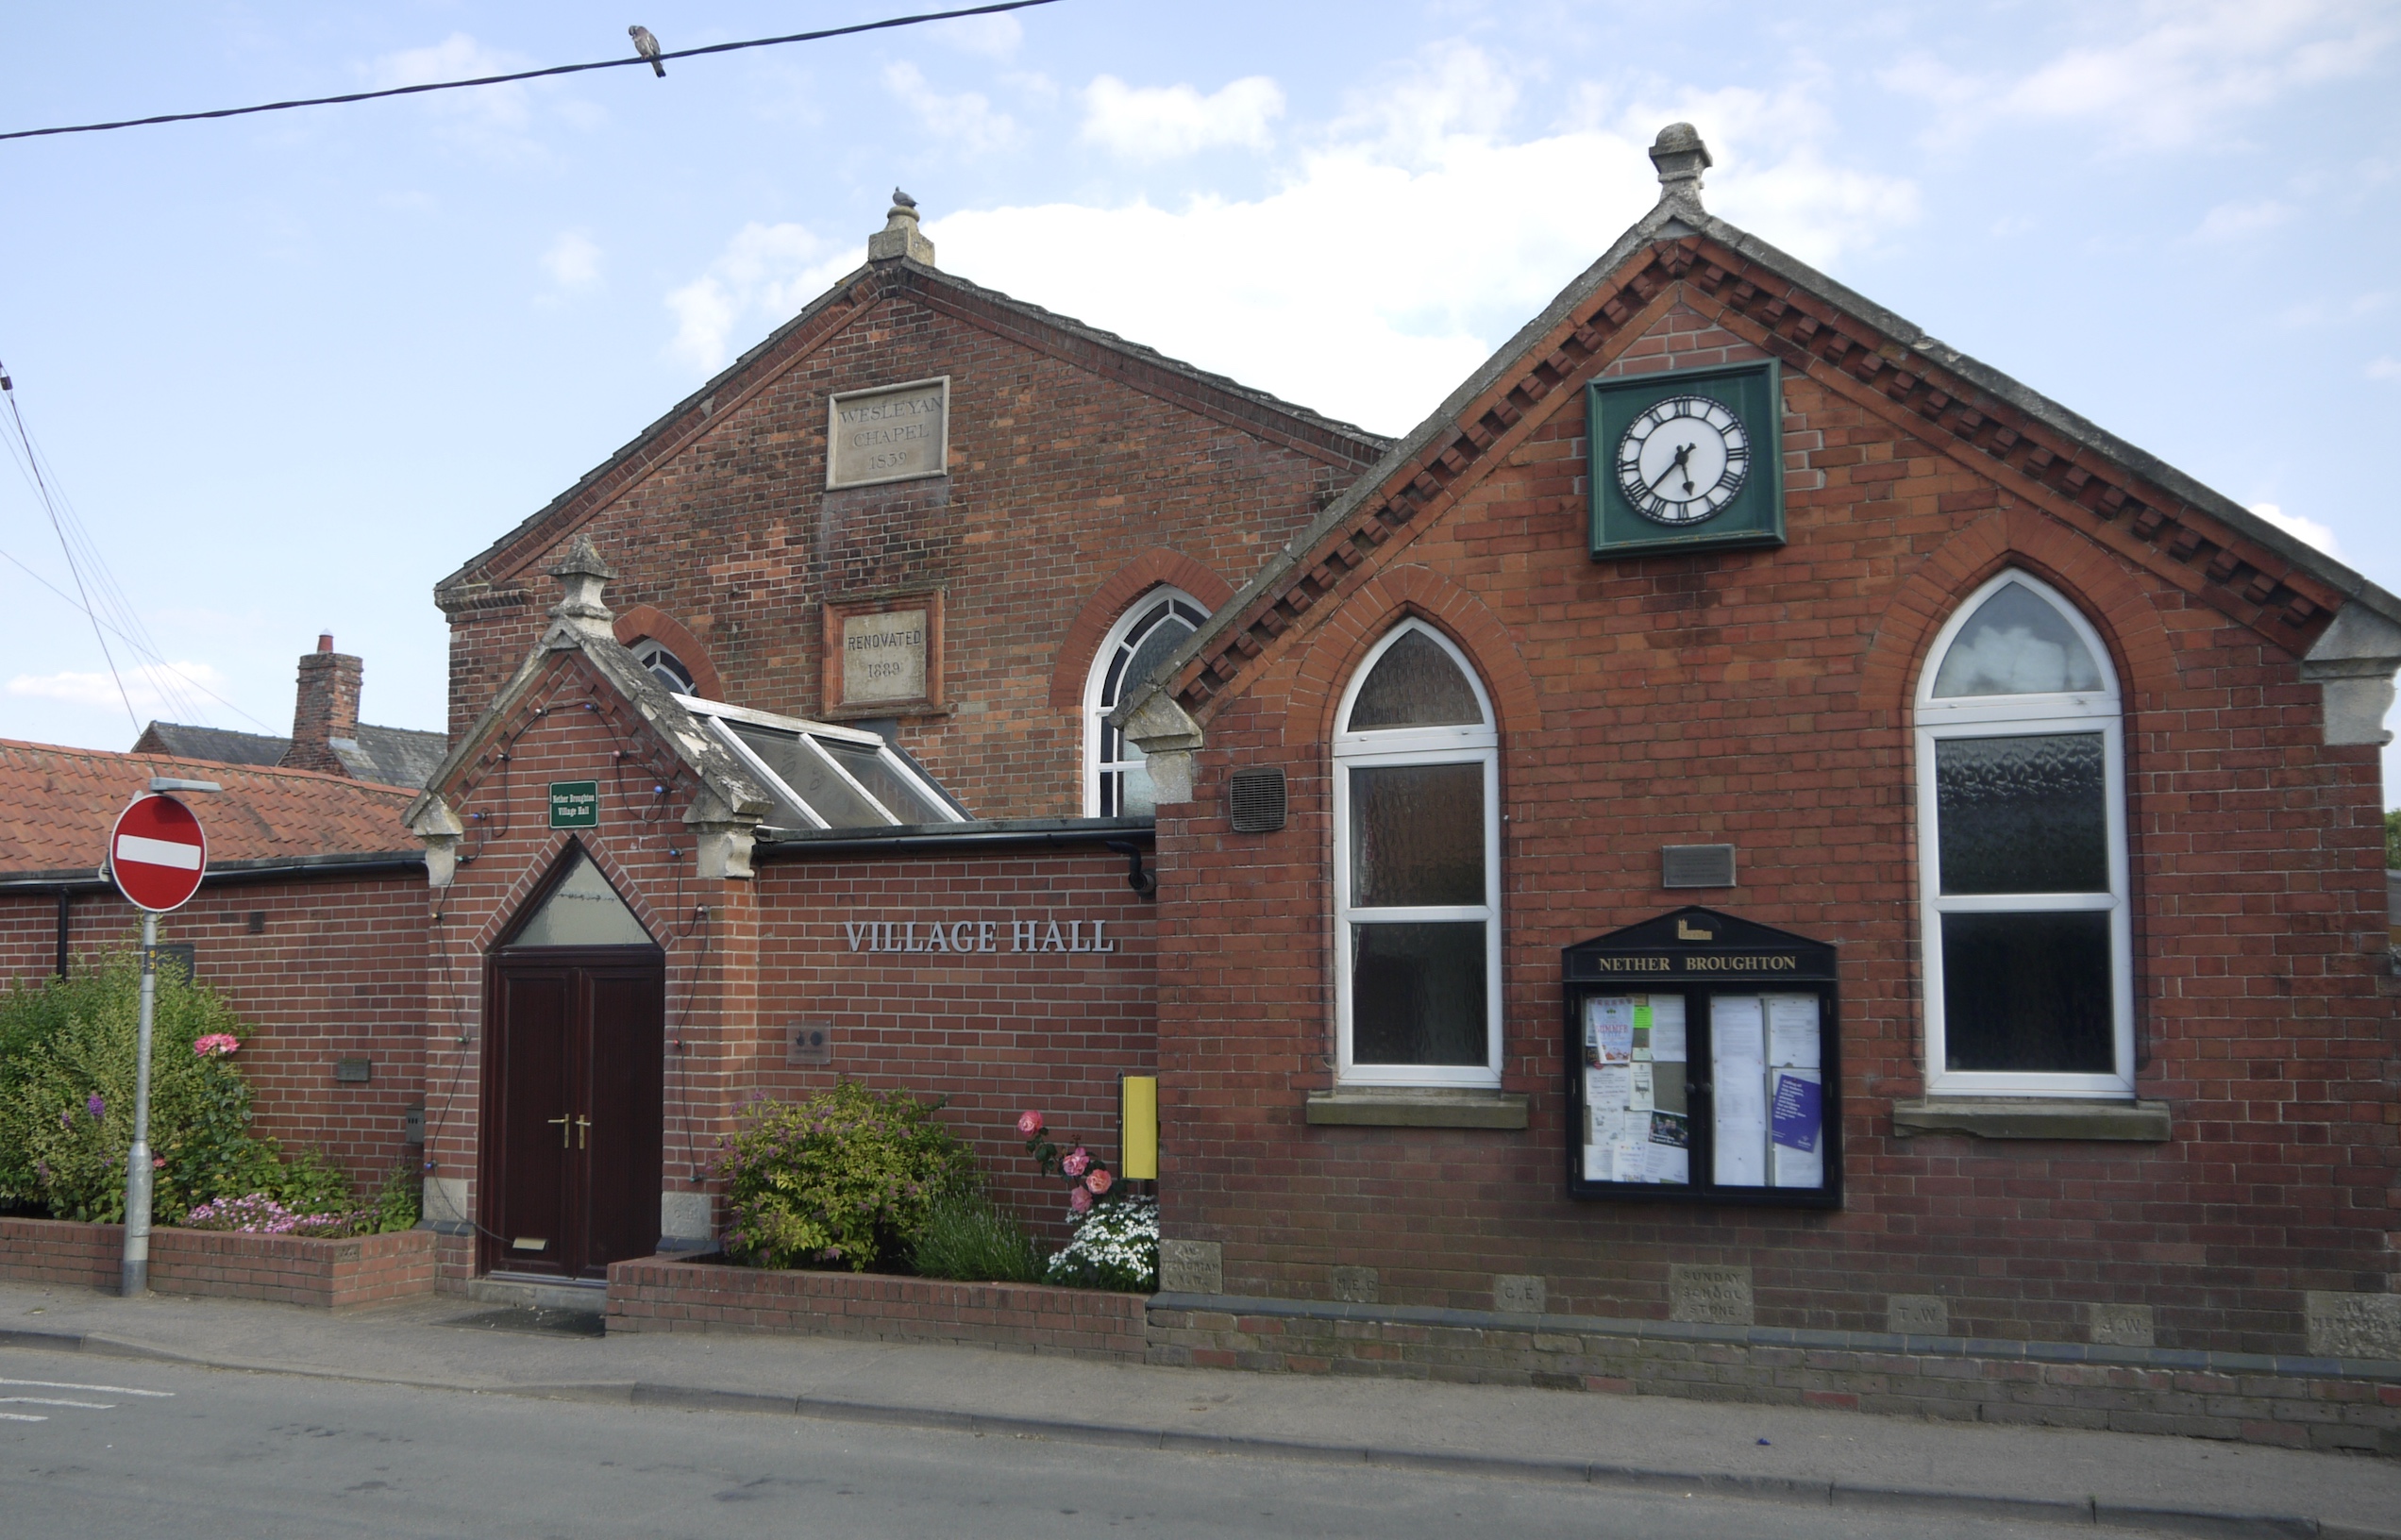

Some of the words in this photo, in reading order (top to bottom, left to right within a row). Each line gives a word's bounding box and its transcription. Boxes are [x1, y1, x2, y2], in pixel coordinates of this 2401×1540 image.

[840, 396, 944, 424] WESLEYAN
[854, 424, 930, 448] CHAPEL
[848, 630, 922, 651] RENOVATED
[868, 661, 901, 678] 1889
[843, 919, 997, 953] VILLAGE
[1011, 919, 1114, 953] HALL
[1599, 957, 1671, 972] NETHER
[1686, 956, 1797, 971] BROUGHTON
[1682, 1271, 1742, 1284] SUNDAY
[1682, 1286, 1742, 1301] SCHOOL
